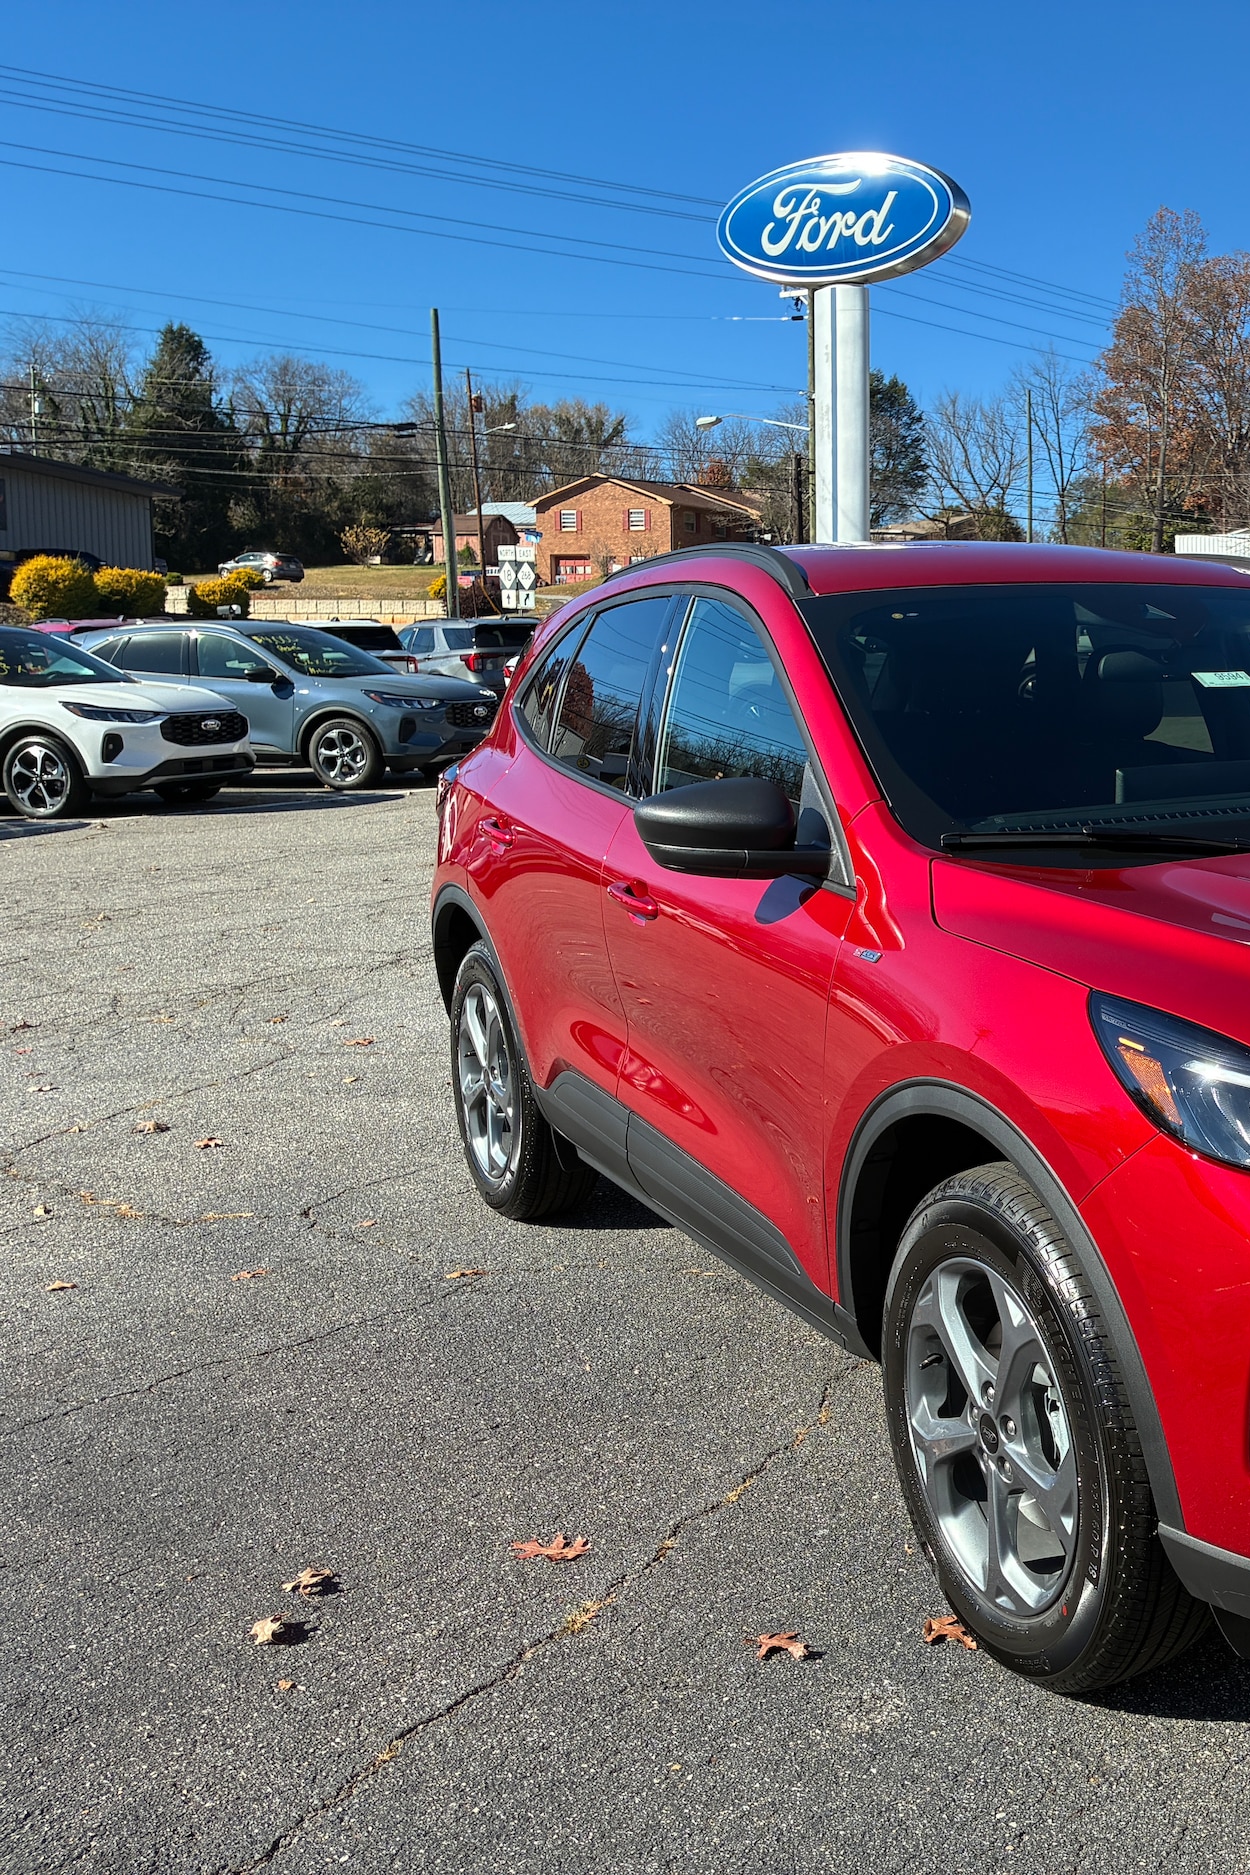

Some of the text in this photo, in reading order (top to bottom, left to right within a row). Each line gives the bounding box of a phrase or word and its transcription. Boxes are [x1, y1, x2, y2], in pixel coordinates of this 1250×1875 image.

[761, 178, 898, 256] Ford
[519, 549, 532, 557] EAST
[503, 569, 512, 581] 18
